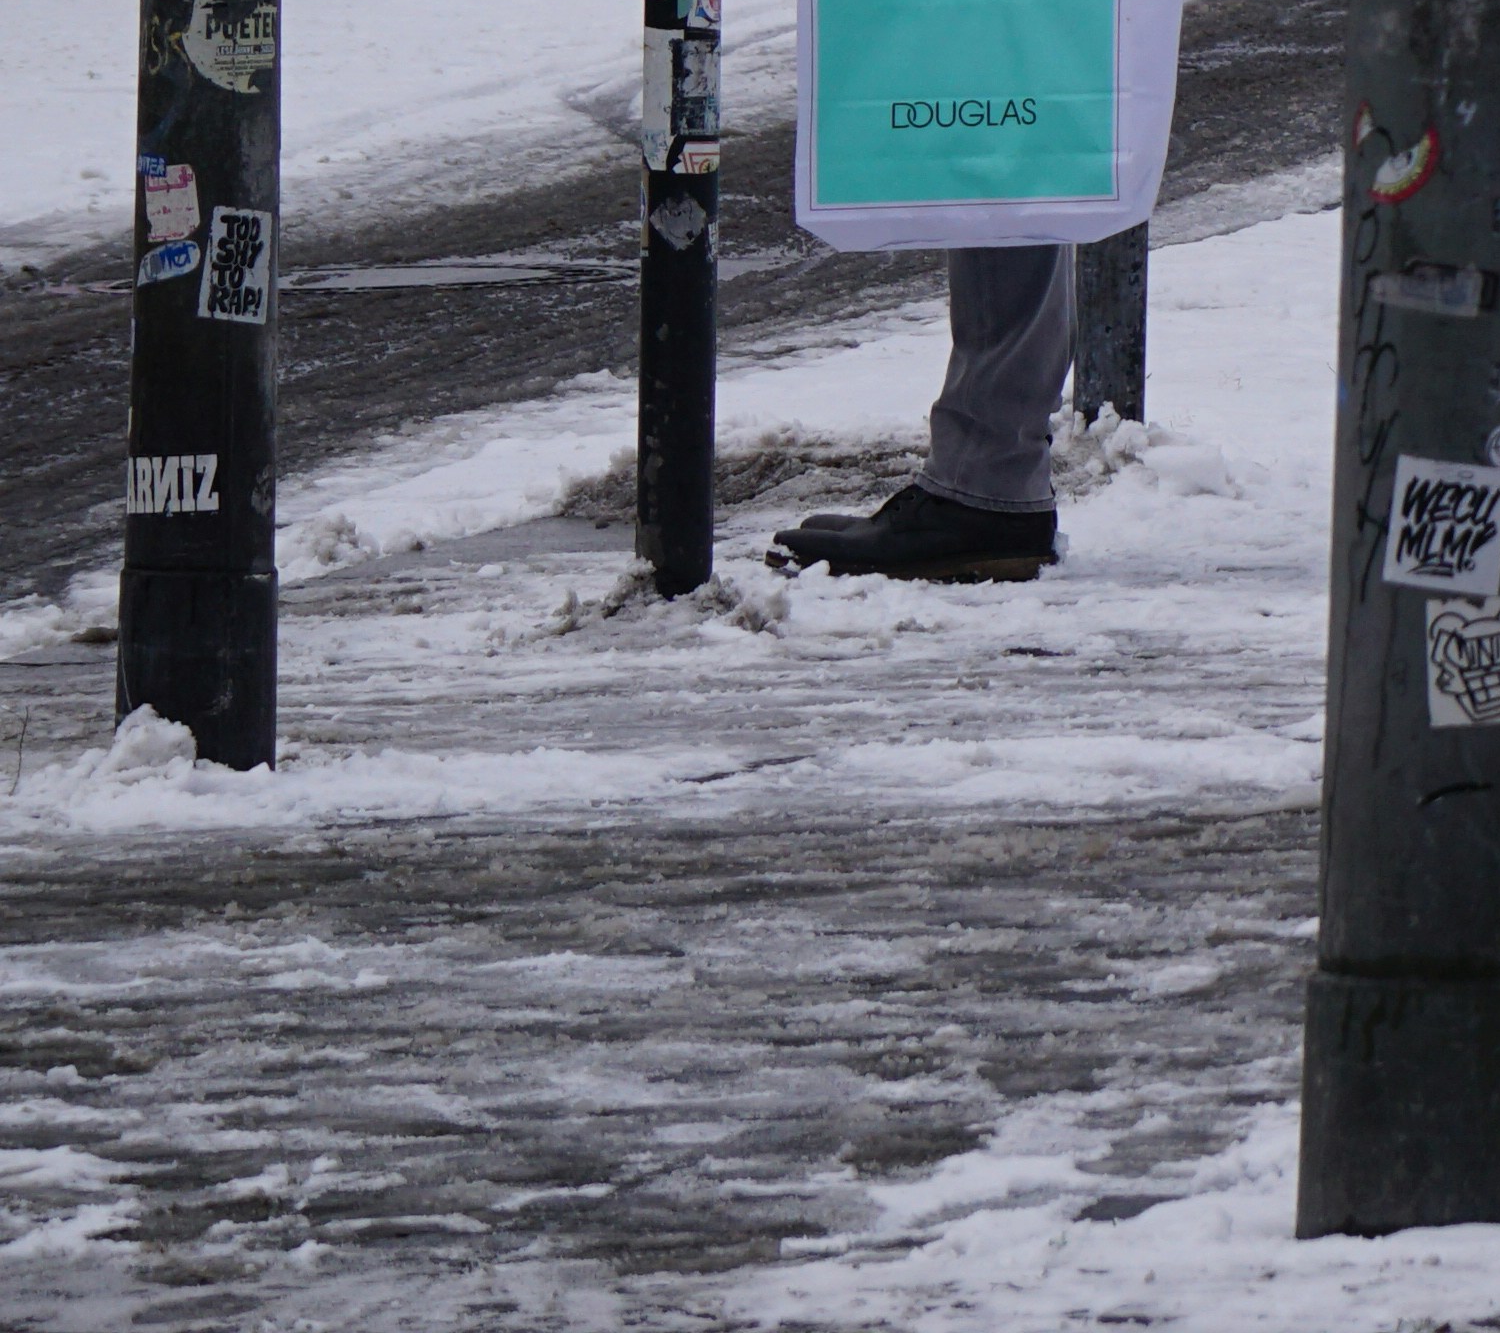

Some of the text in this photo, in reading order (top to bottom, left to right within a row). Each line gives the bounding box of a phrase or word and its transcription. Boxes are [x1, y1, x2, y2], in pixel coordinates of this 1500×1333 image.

[891, 98, 1037, 129] DOUGLAS
[221, 215, 261, 241] TOO
[216, 238, 264, 267] SHY
[213, 263, 245, 288] TO
[208, 287, 263, 317] RAP!
